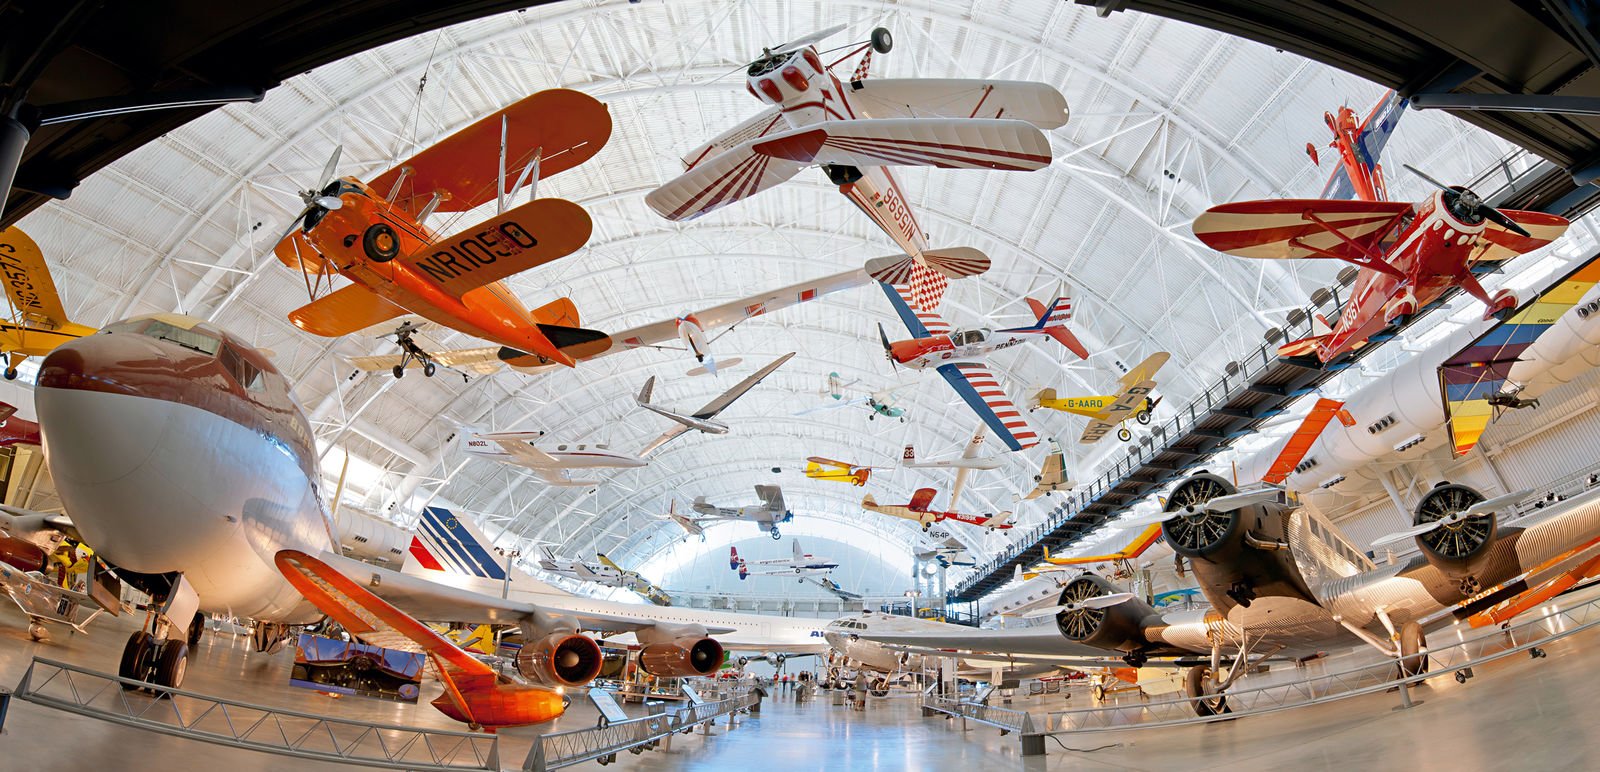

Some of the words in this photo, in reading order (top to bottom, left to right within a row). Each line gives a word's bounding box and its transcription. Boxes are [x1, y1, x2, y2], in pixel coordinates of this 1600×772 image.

[884, 187, 916, 241] N15696
[415, 221, 538, 282] NR1050
[1341, 294, 1361, 333] N36Y
[904, 448, 915, 458] 33
[929, 531, 950, 539] N54P
